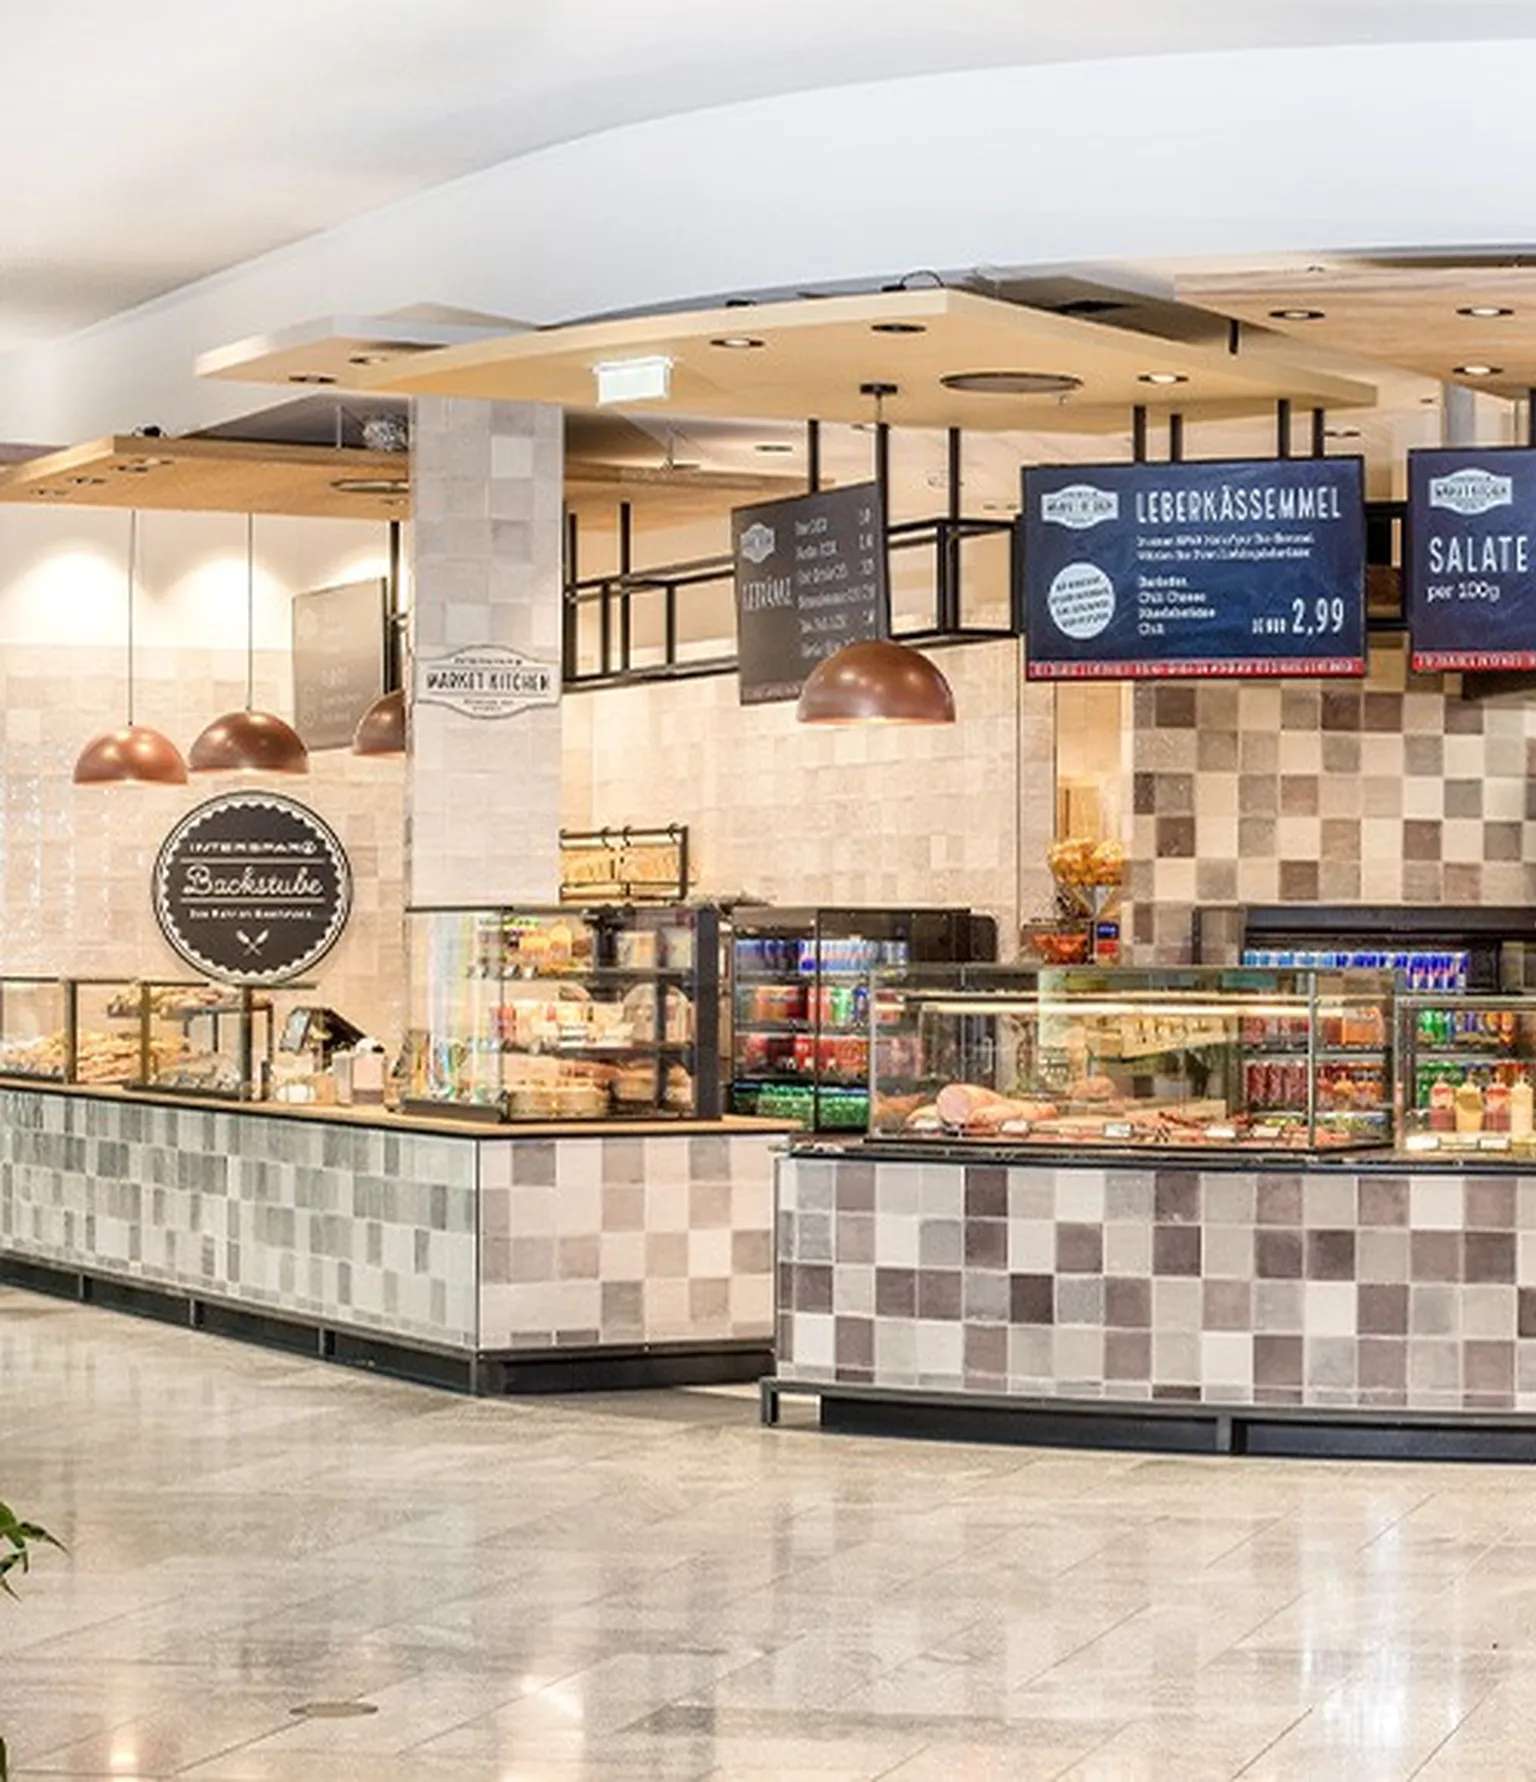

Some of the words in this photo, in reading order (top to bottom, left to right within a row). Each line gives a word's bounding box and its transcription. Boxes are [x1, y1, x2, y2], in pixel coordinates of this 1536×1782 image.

[1135, 485, 1342, 523] LEBERKÄSSEMMEL
[1428, 536, 1529, 574] SALATE
[1426, 583, 1453, 603] per
[1458, 580, 1501, 603] 100g
[1292, 597, 1345, 635] 2,99
[426, 671, 484, 690] MARKET
[490, 672, 551, 691] KITCHEN
[183, 864, 324, 896] Backstube
